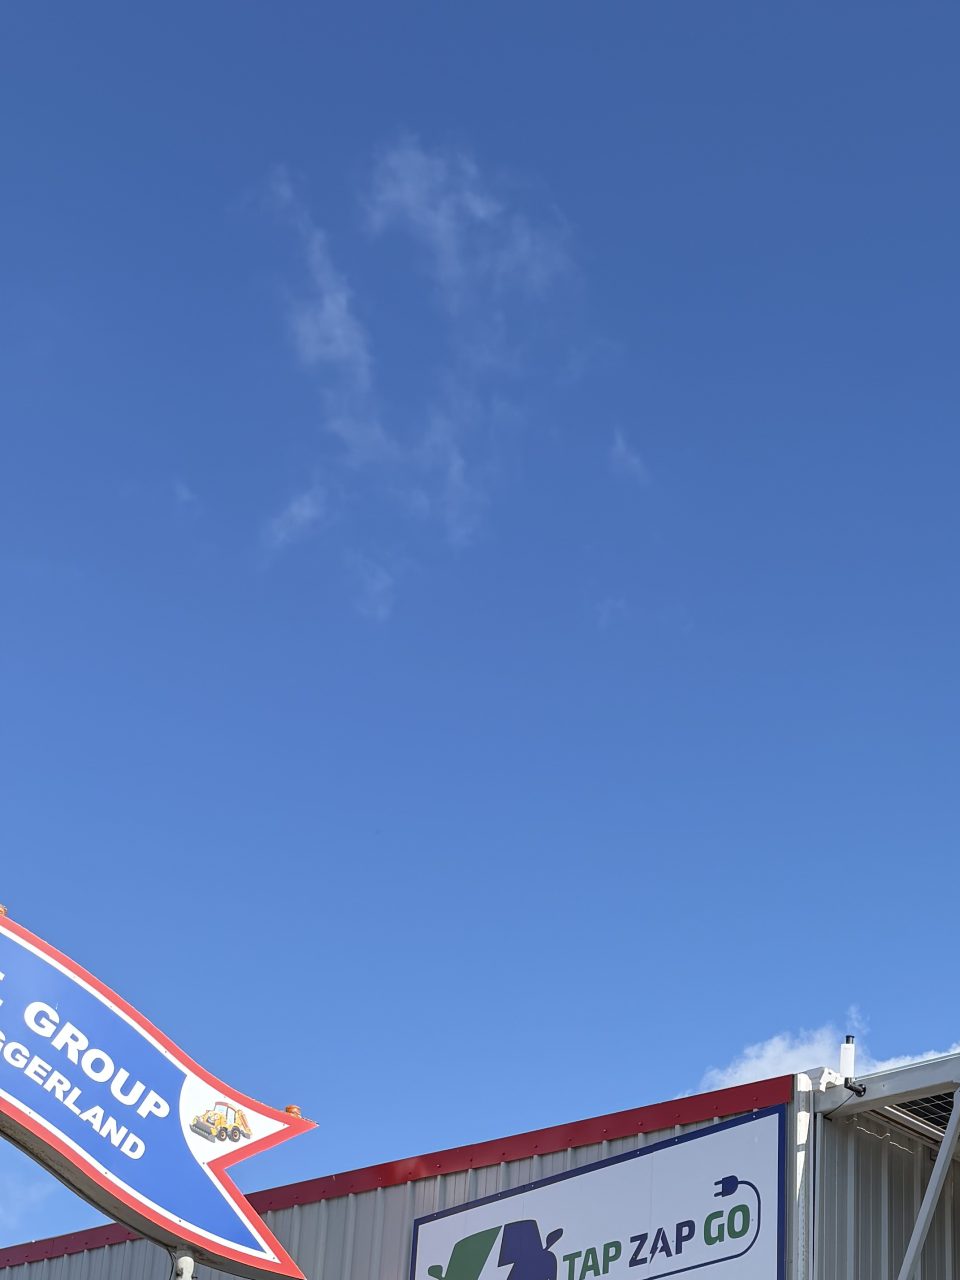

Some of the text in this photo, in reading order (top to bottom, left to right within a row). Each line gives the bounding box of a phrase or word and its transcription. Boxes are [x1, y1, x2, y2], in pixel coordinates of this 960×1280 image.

[24, 1001, 170, 1120] GROUP
[629, 1219, 696, 1268] ZAP
[703, 1203, 751, 1246] GO
